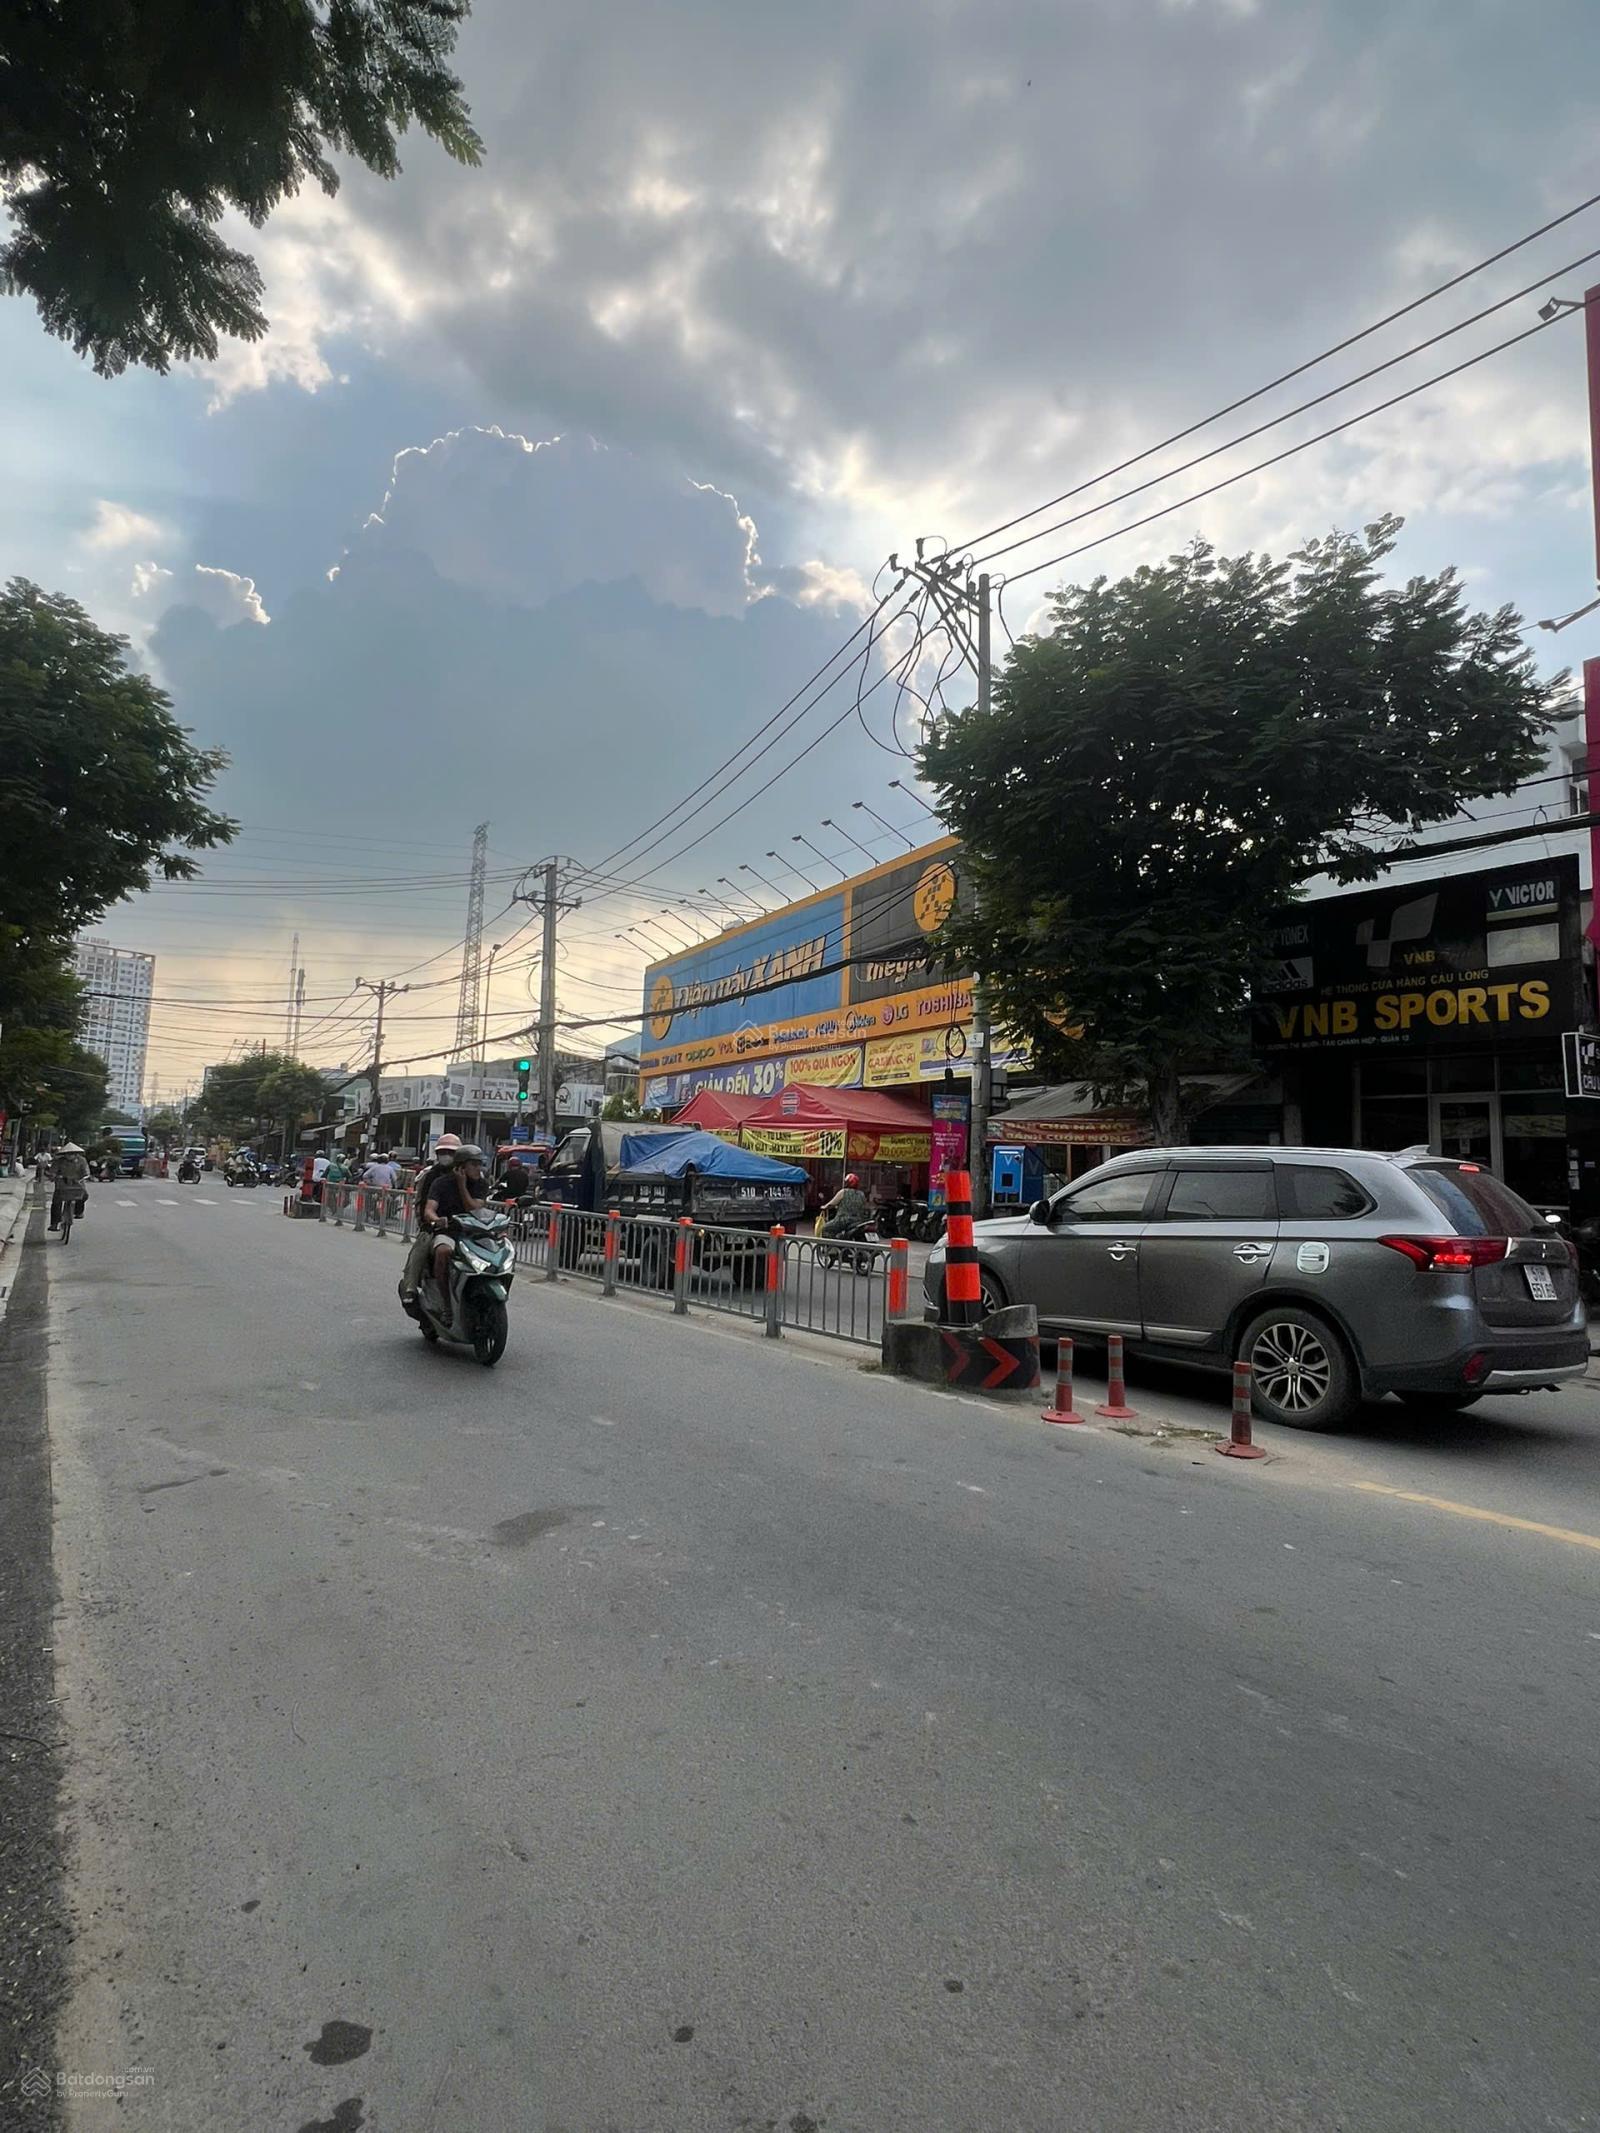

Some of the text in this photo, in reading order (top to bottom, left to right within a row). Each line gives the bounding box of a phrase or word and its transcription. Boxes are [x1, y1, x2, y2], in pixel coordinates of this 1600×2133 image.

[1505, 880, 1555, 905] VICTOR
[750, 934, 827, 990] XANH
[1403, 951, 1435, 966] VNB
[896, 1005, 909, 1021] LG
[916, 991, 974, 1016] TOSHIBA
[1277, 980, 1550, 1039] VNB SPORTS
[726, 1066, 751, 1095] ĐẾN
[752, 1061, 784, 1095] 30%
